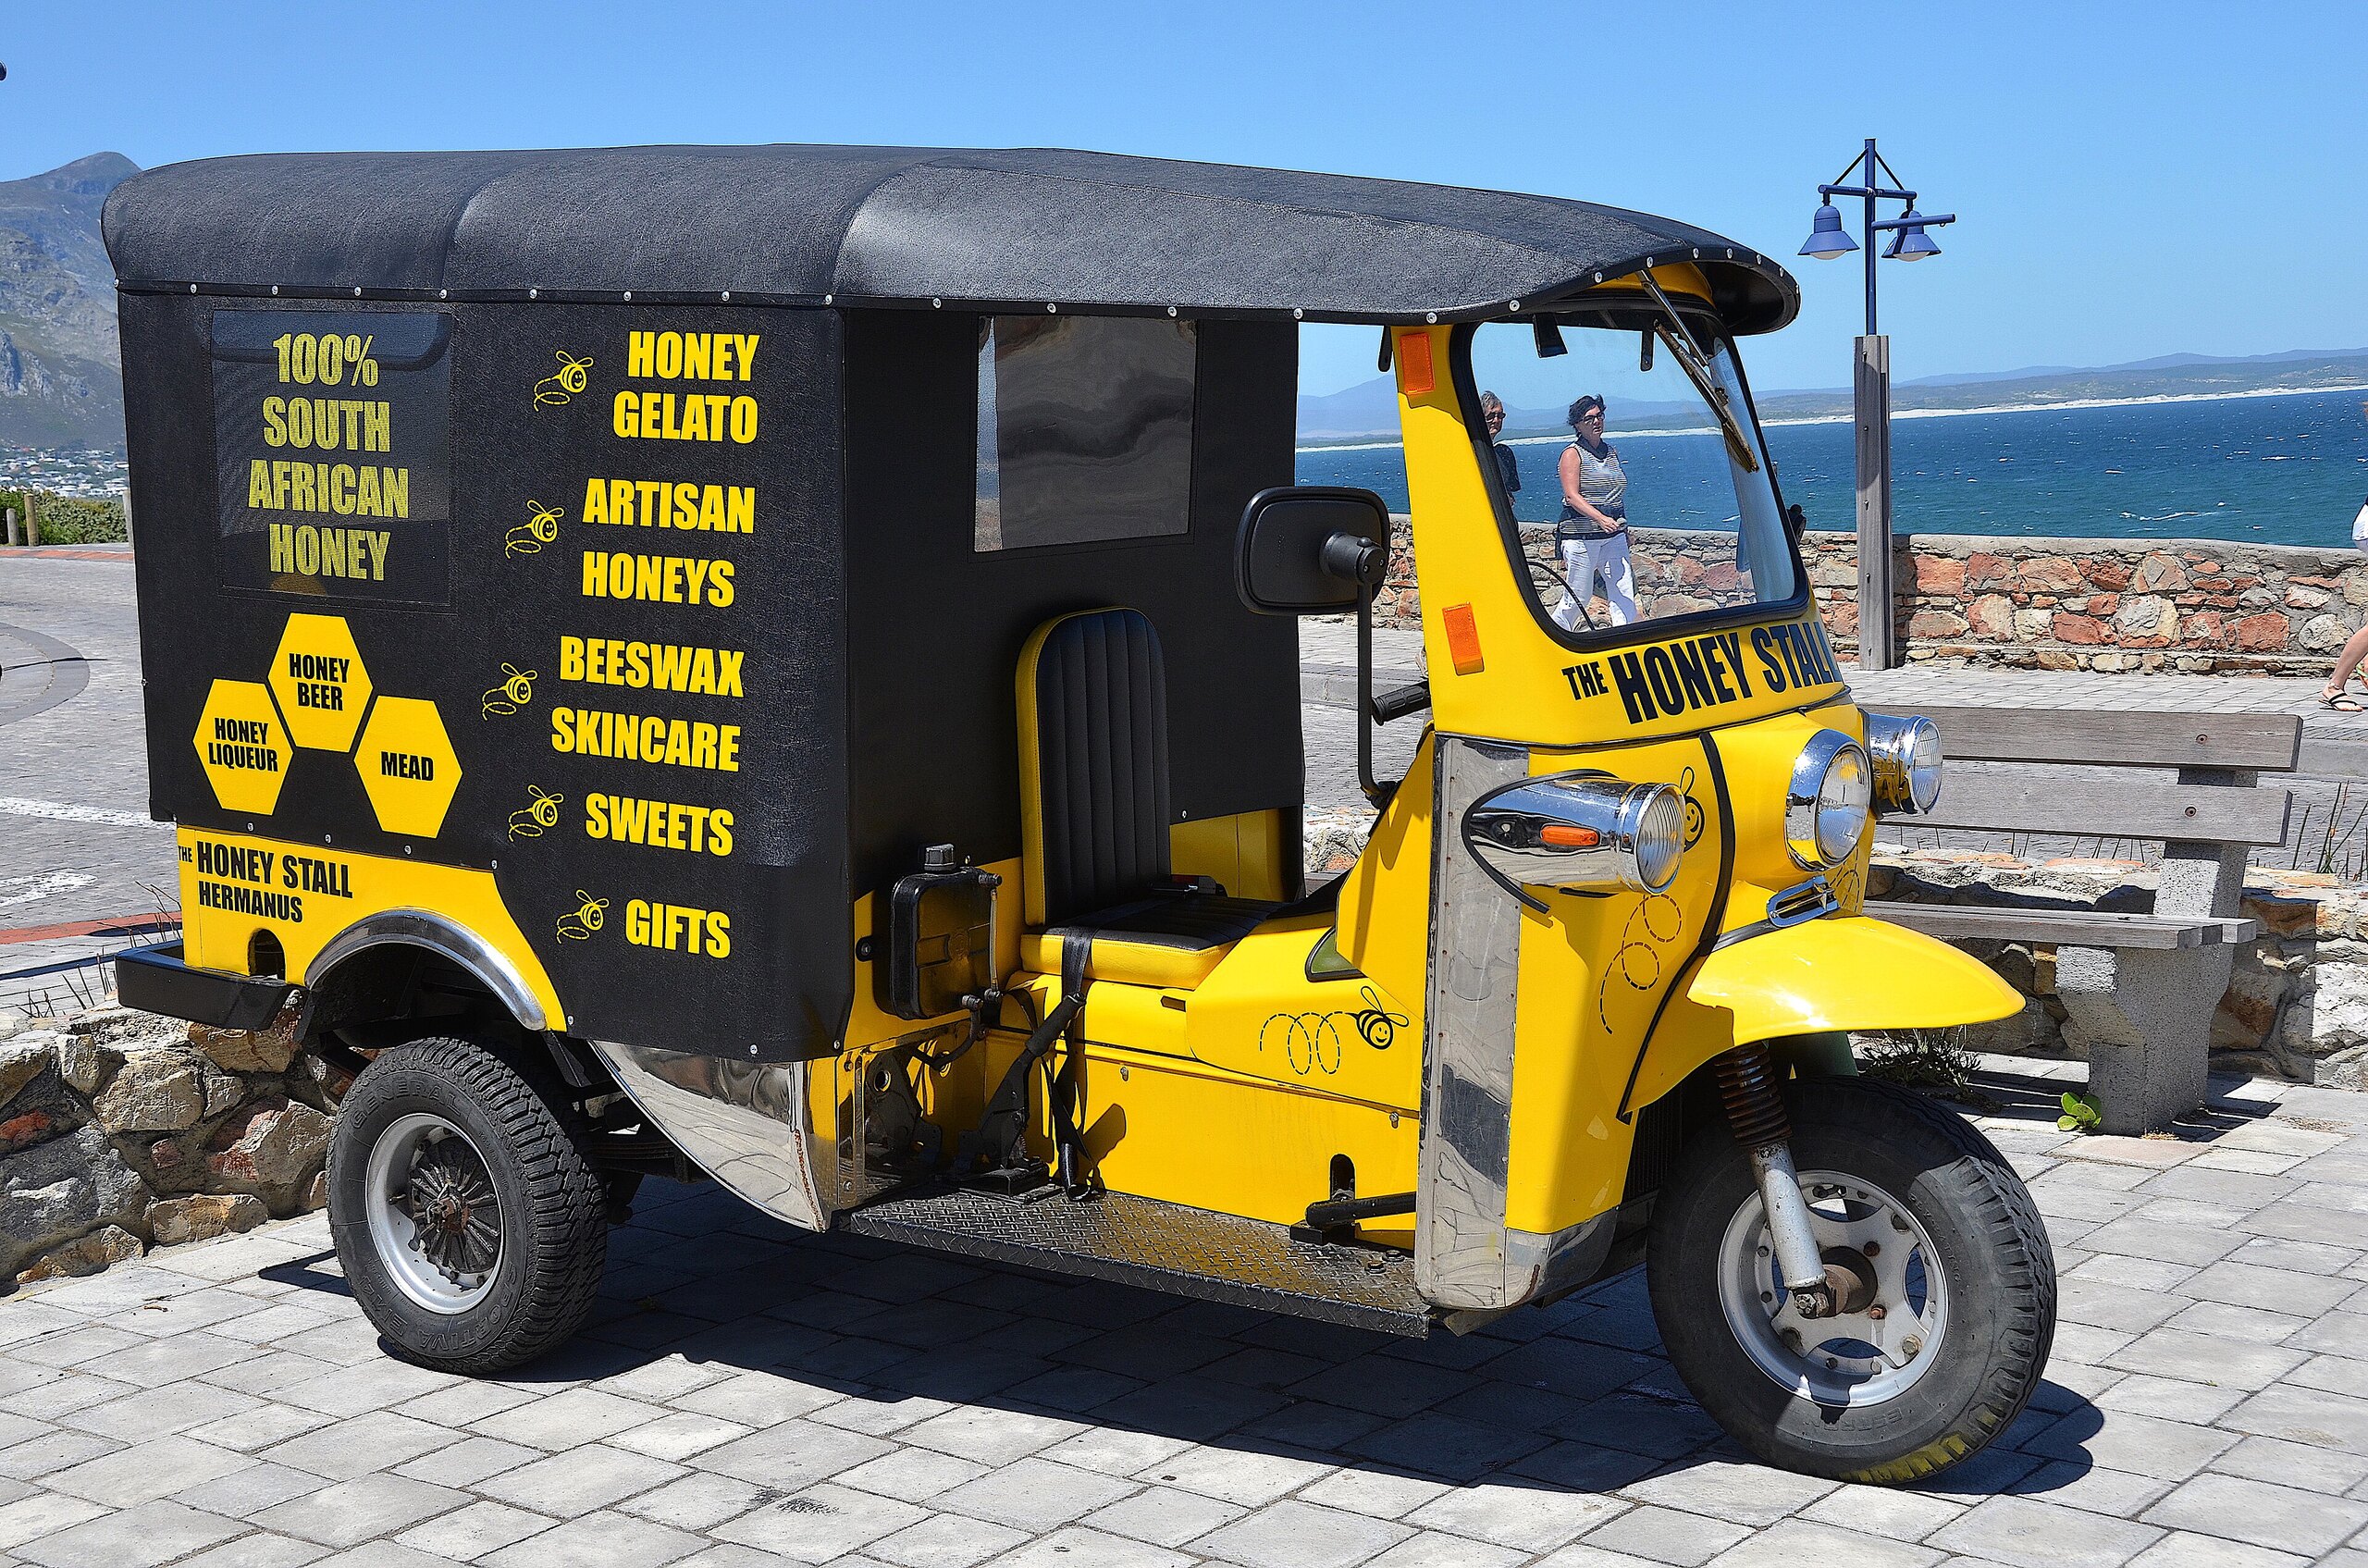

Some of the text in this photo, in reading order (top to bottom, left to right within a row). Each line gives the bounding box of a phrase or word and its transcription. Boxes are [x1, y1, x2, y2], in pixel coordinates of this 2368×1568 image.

[275, 334, 378, 386] 100%
[627, 330, 760, 382] HONEY
[264, 397, 390, 452] SOUTH
[612, 390, 758, 444] GELATO
[249, 460, 409, 519] AFRICAN
[582, 477, 756, 534] ARTISAN
[270, 523, 390, 581] HONEY
[582, 550, 735, 608] HONEYS
[289, 652, 351, 682] HONEY
[560, 636, 745, 698] BEESWAX
[1562, 622, 1843, 724] THE HONEY STALL
[297, 683, 343, 711] BEER
[208, 741, 278, 772] LIQUEUR
[214, 717, 269, 746] HONEY
[551, 706, 741, 772] SKINCARE
[381, 751, 434, 782] MEAD
[586, 792, 734, 857] SWEETS
[178, 841, 353, 899] THE HONEY STALL
[198, 880, 303, 923] HERMANUS
[625, 898, 731, 959] GIFTS
[352, 1077, 462, 1129] GENERAL
